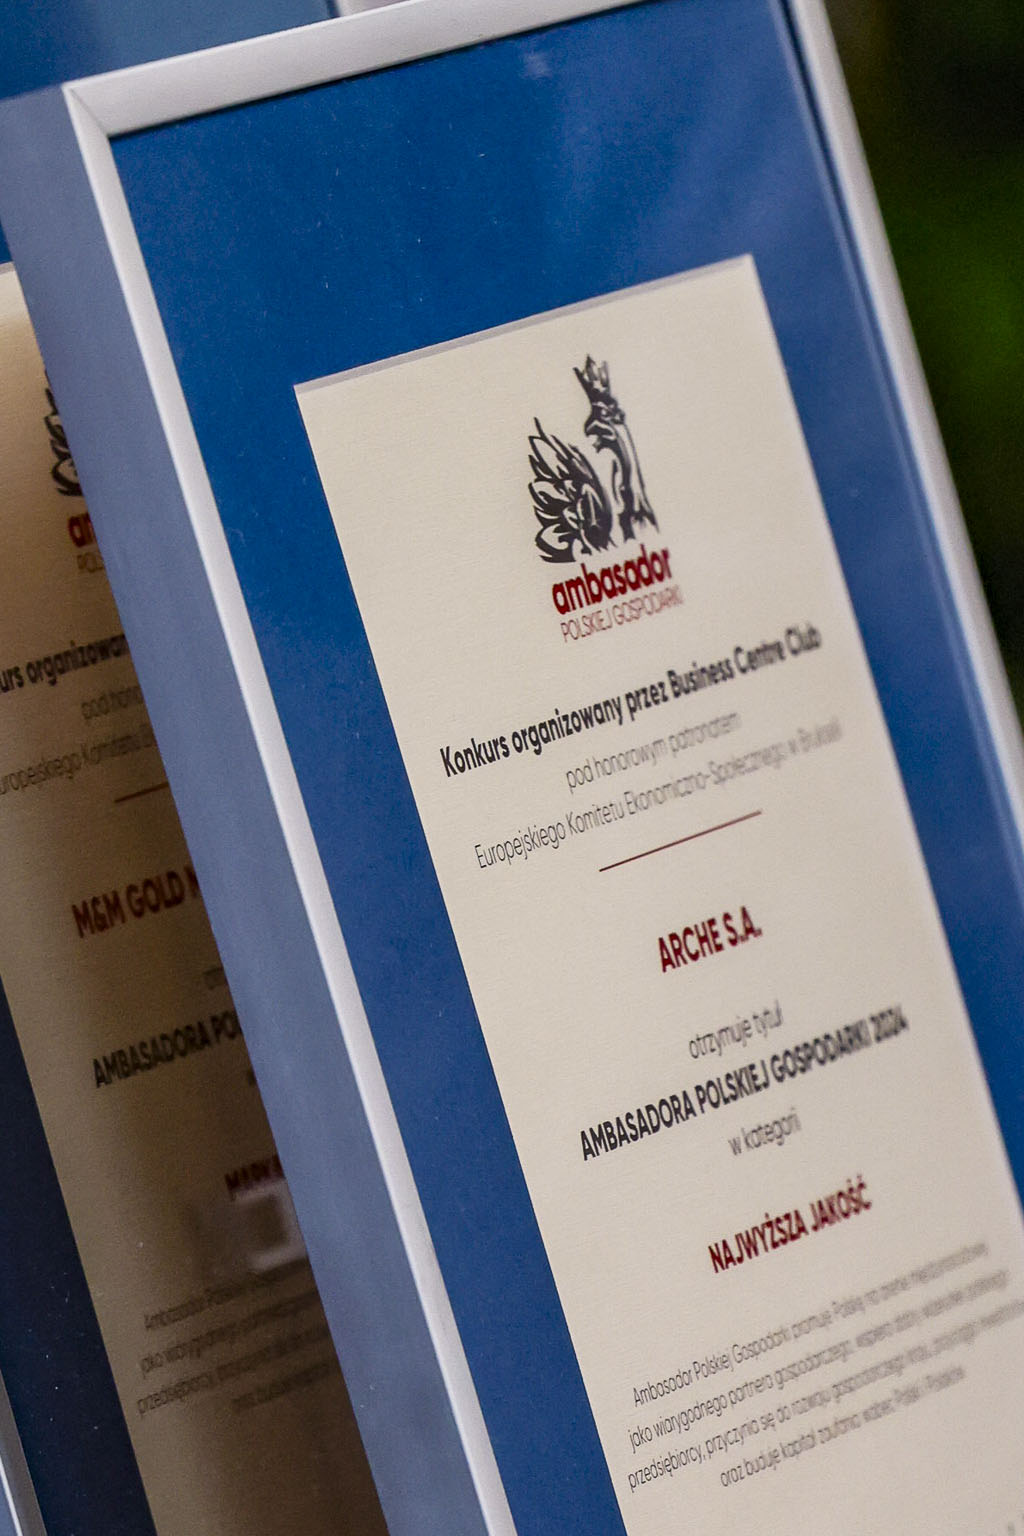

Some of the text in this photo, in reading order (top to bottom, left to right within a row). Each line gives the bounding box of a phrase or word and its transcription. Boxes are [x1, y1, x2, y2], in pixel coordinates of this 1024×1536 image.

[552, 545, 672, 615] ambasador
[560, 610, 612, 642] POLSKIEJ
[440, 624, 821, 777] Konkurs organizowany przez Business Centre Club
[566, 759, 594, 794] pod
[592, 739, 666, 778] honorowym
[474, 822, 566, 868] Europejskiego
[566, 803, 625, 835] Komitetu
[72, 890, 126, 938] M&M
[127, 869, 185, 918] GOLD
[658, 906, 762, 972] ARCHE S.A.
[93, 1020, 210, 1088] AMBASADORA
[689, 1001, 783, 1059] otrzymuje tytuł
[581, 1090, 697, 1161] AMBASADORA
[694, 1061, 769, 1113] POLSKIEJ
[770, 1021, 870, 1083] GOSPODARKI
[728, 1107, 800, 1156] w kategorii
[708, 1210, 808, 1273] NAJWYŻSZA
[810, 1176, 871, 1232] JAKOŚĆ
[628, 1426, 653, 1454] jako
[653, 1395, 727, 1437] wiarygodnego
[728, 1374, 773, 1407] partnera
[633, 1370, 692, 1407] Ambasador
[692, 1354, 733, 1380] Polskiej
[628, 1445, 705, 1493] przedsiębiorcy,
[705, 1420, 760, 1459] przyczynia
[760, 1413, 775, 1430] się
[720, 1465, 745, 1487] oraz
[743, 1449, 781, 1476] buduje
